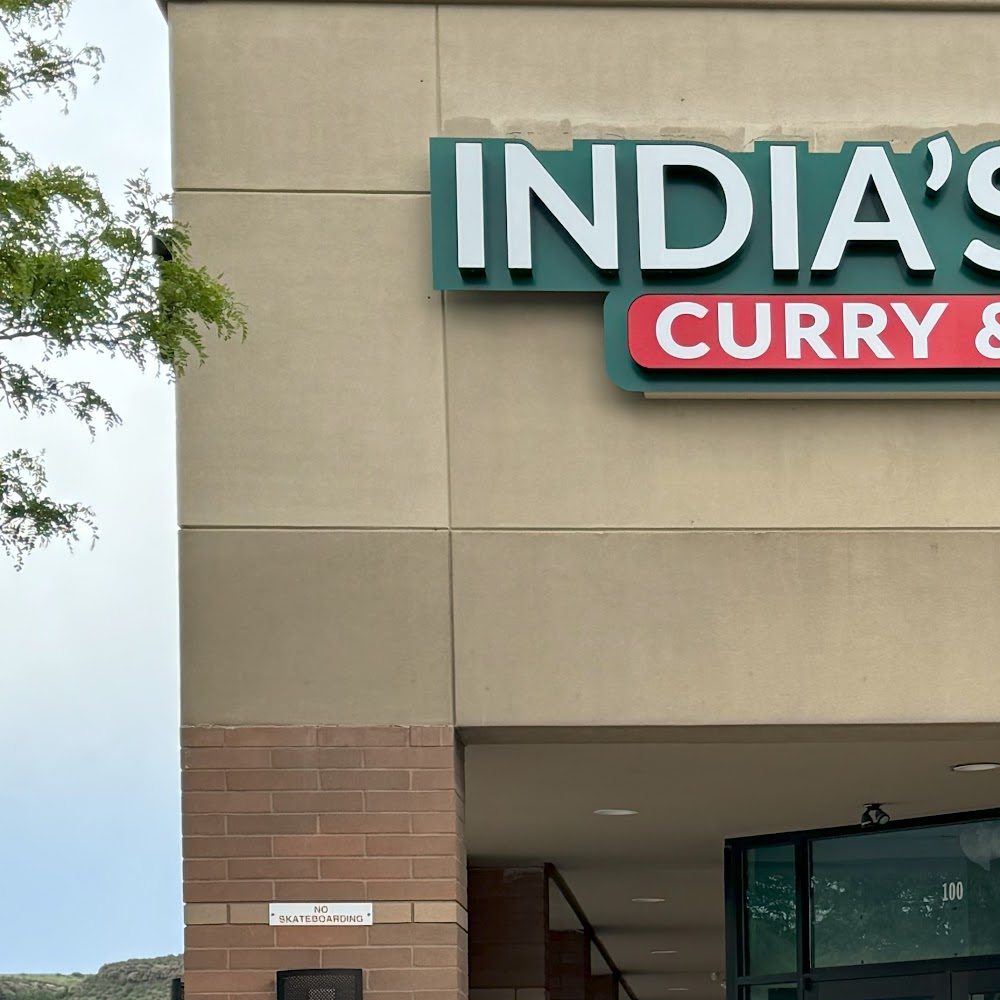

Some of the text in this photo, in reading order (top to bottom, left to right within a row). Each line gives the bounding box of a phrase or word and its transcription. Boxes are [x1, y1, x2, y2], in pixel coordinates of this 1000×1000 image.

[654, 300, 949, 360] CURRY
[942, 881, 964, 901] 100
[314, 905, 329, 914] NO
[279, 915, 364, 923] SKATEBOARDING
